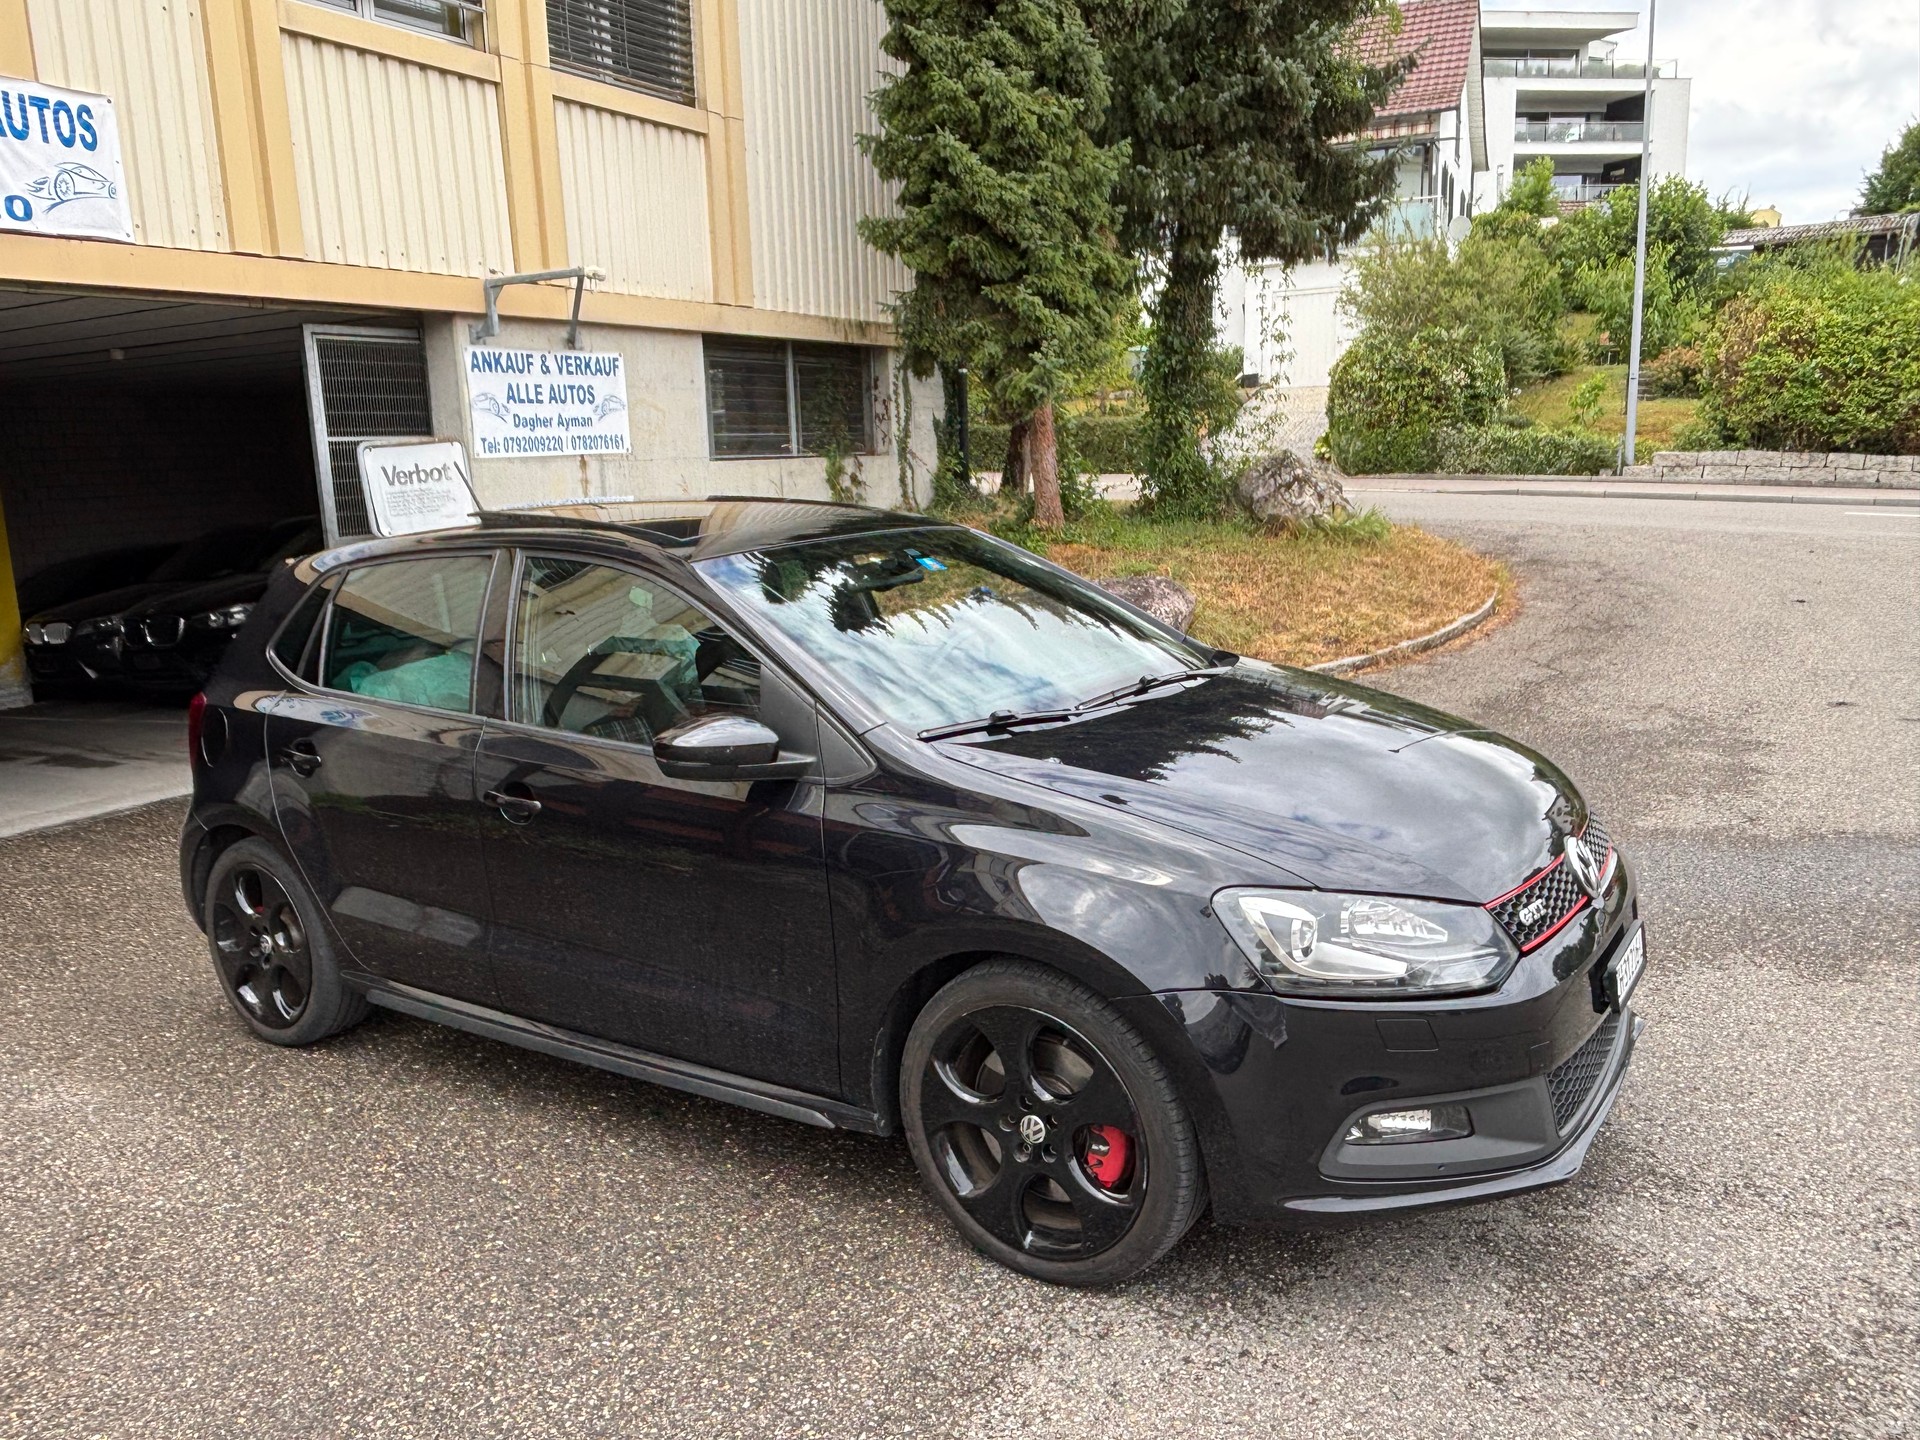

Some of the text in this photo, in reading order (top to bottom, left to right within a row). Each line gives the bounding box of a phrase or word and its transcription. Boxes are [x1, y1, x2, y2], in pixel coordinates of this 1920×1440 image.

[470, 351, 620, 377] ANKAUF & VERKAUF
[506, 382, 596, 405] ALLE AUTOS
[512, 413, 593, 432] Dagher Ayman
[480, 437, 501, 454] Tel:
[503, 435, 564, 453] 0792009220
[571, 433, 625, 450] 0782076161
